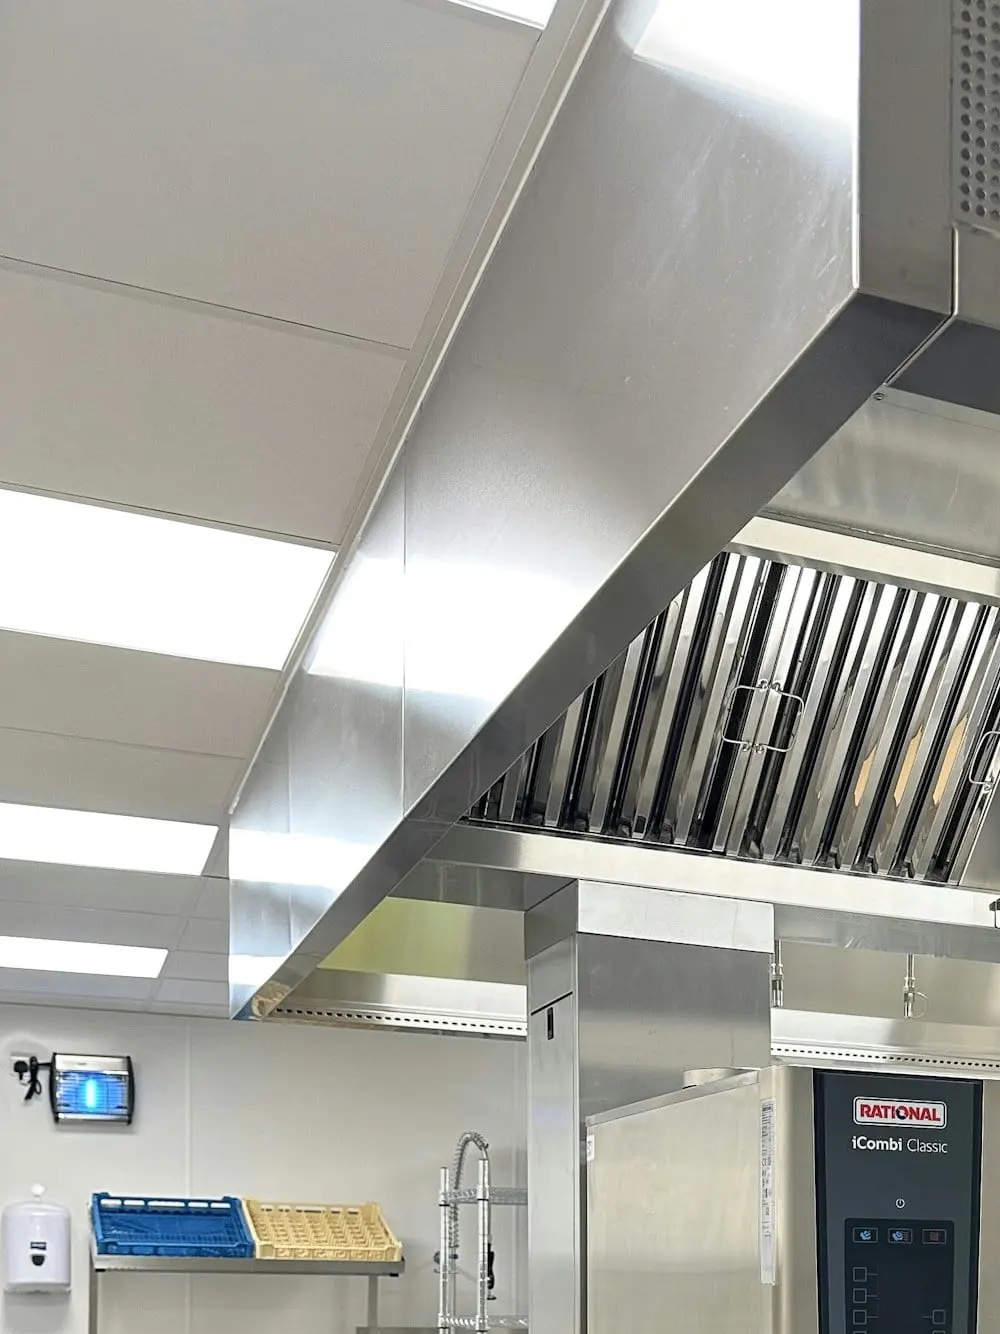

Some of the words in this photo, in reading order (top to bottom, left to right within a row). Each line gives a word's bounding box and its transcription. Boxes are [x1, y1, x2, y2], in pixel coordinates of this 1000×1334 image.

[860, 1103, 941, 1122] RATIONAL
[852, 1136, 902, 1152] iCombi
[907, 1139, 948, 1153] Classic
